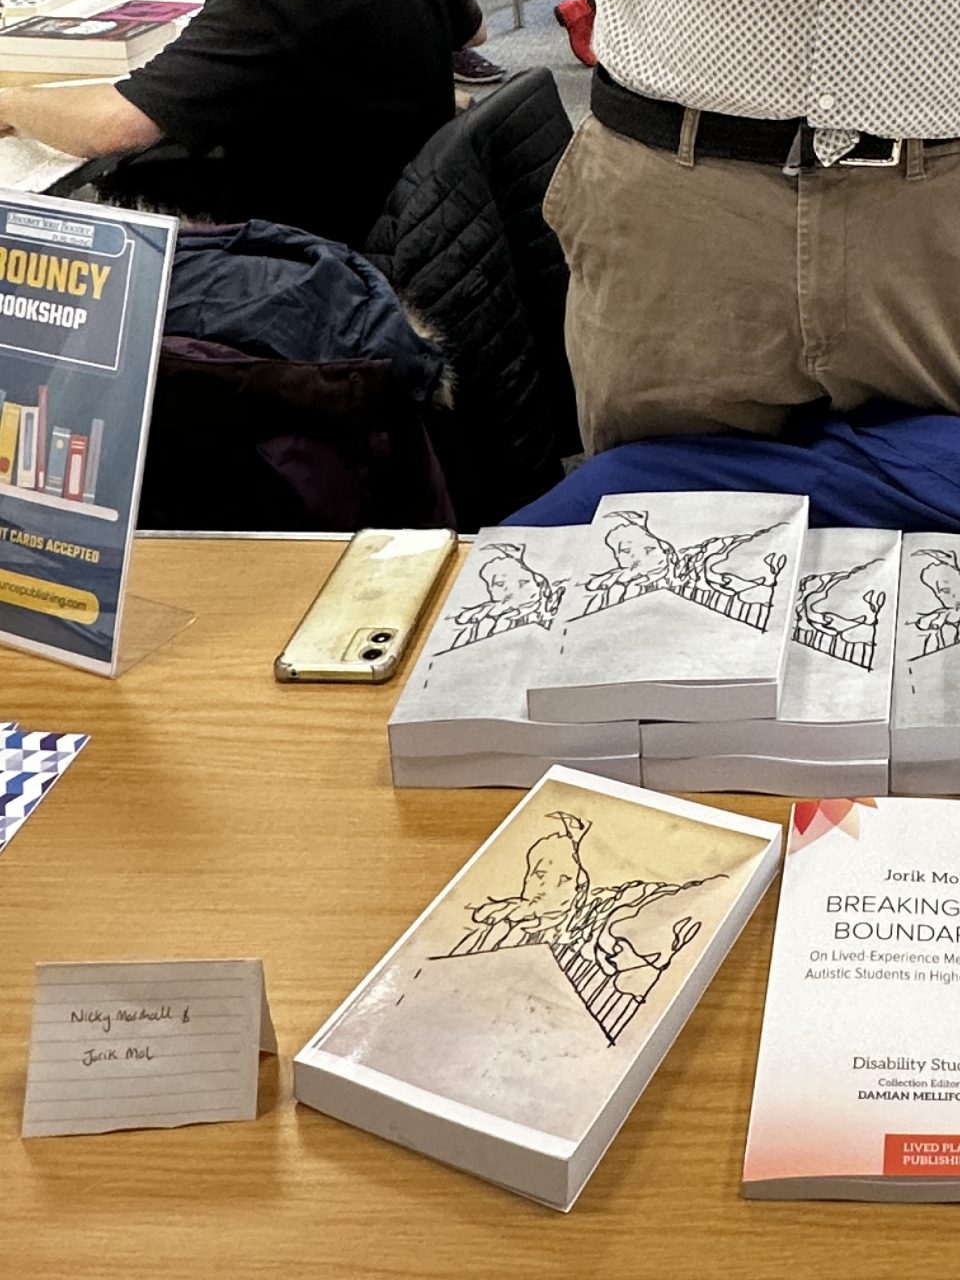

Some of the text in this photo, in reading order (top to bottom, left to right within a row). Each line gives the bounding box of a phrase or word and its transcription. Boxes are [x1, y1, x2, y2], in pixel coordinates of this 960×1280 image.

[0, 293, 87, 329] OOKSHOP
[10, 529, 44, 550] CARDS
[45, 539, 100, 563] ACCEPTED
[884, 869, 926, 883] Jorik
[826, 895, 960, 917] BREAKING
[809, 950, 828, 962] On
[804, 967, 851, 980] Autistic
[855, 967, 911, 981] Students
[914, 970, 925, 982] in
[71, 1008, 111, 1033] Nicky
[853, 1056, 926, 1072] Disability
[878, 1078, 960, 1088] Collection Editor
[858, 1090, 910, 1101] DAMIAN
[903, 1142, 940, 1153] LIVED
